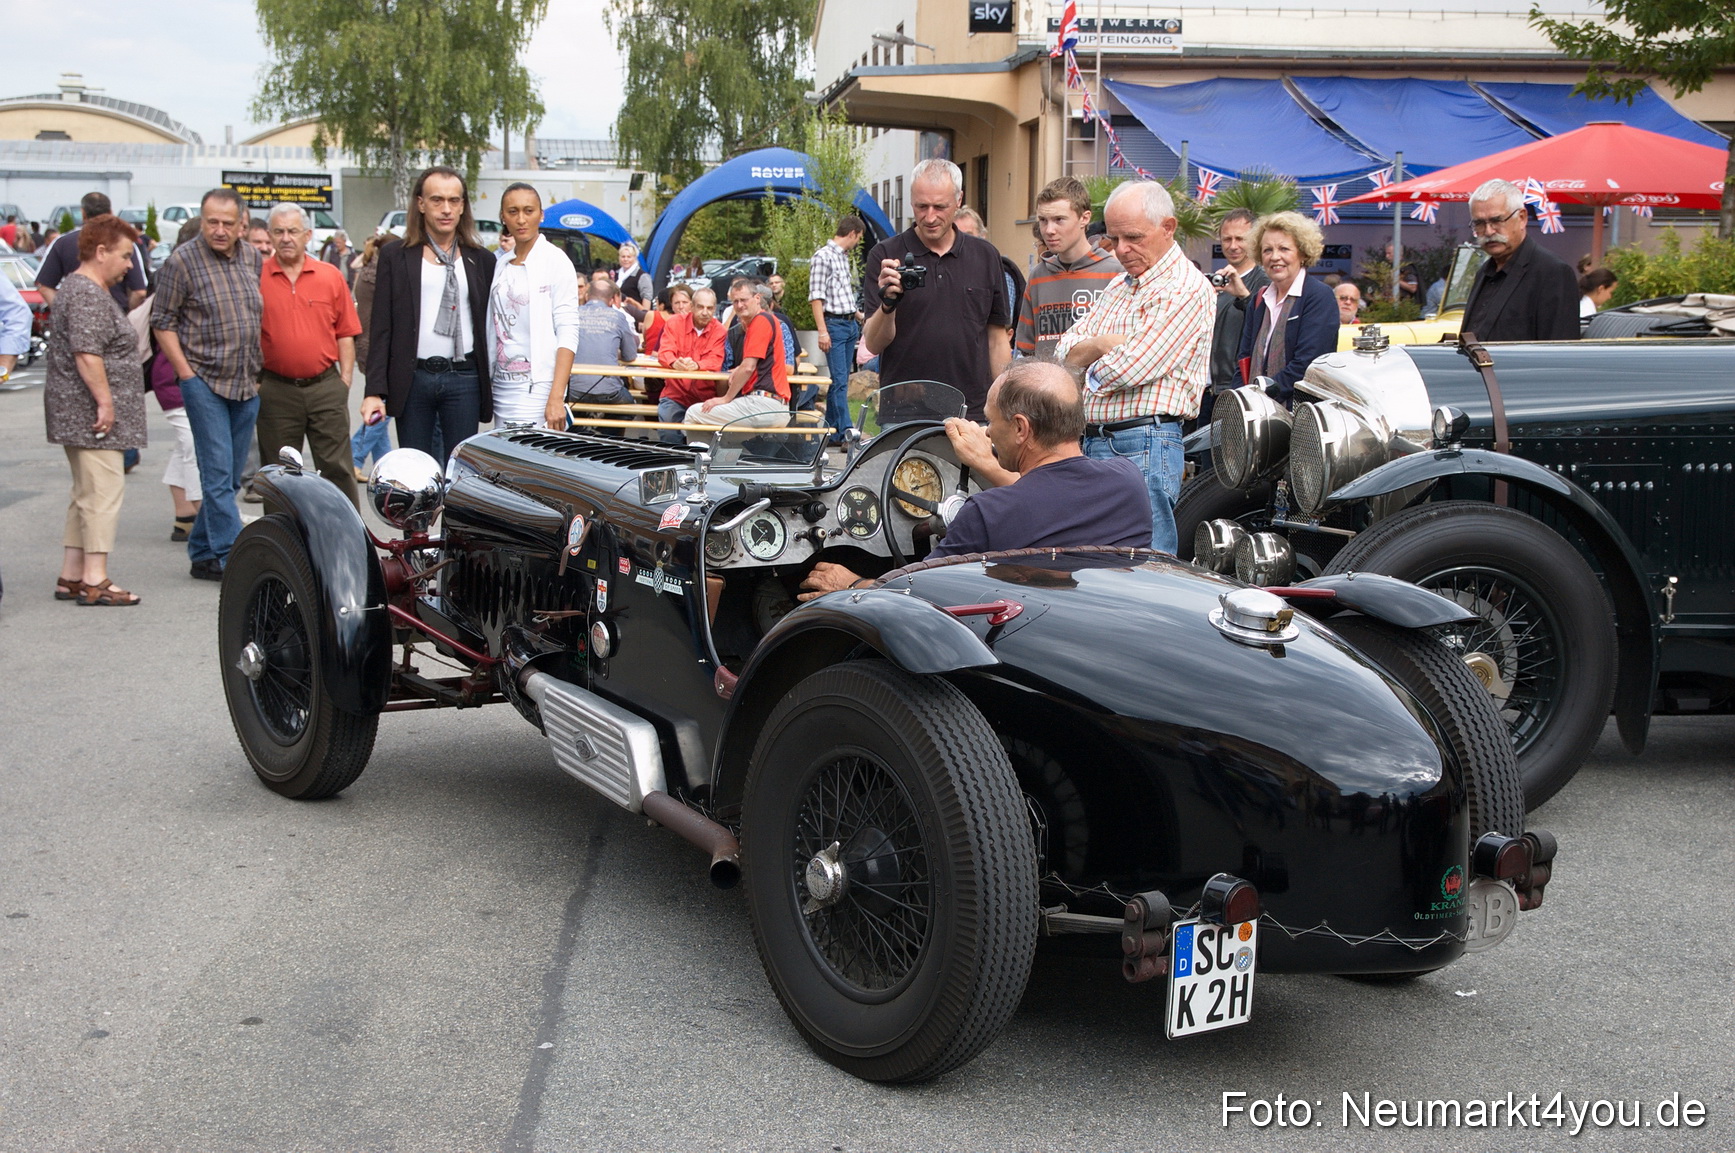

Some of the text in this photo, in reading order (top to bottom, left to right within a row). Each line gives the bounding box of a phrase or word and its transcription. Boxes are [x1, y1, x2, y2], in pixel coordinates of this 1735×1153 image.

[974, 2, 1008, 24] sky
[1051, 18, 1163, 27] OENWERK
[1078, 35, 1173, 45] UPTEINGANG
[272, 174, 330, 187] Jahreswagen
[236, 185, 251, 193] Wir
[1195, 925, 1235, 976] SC
[1180, 958, 1188, 971] D
[1176, 972, 1250, 1030] K 2H
